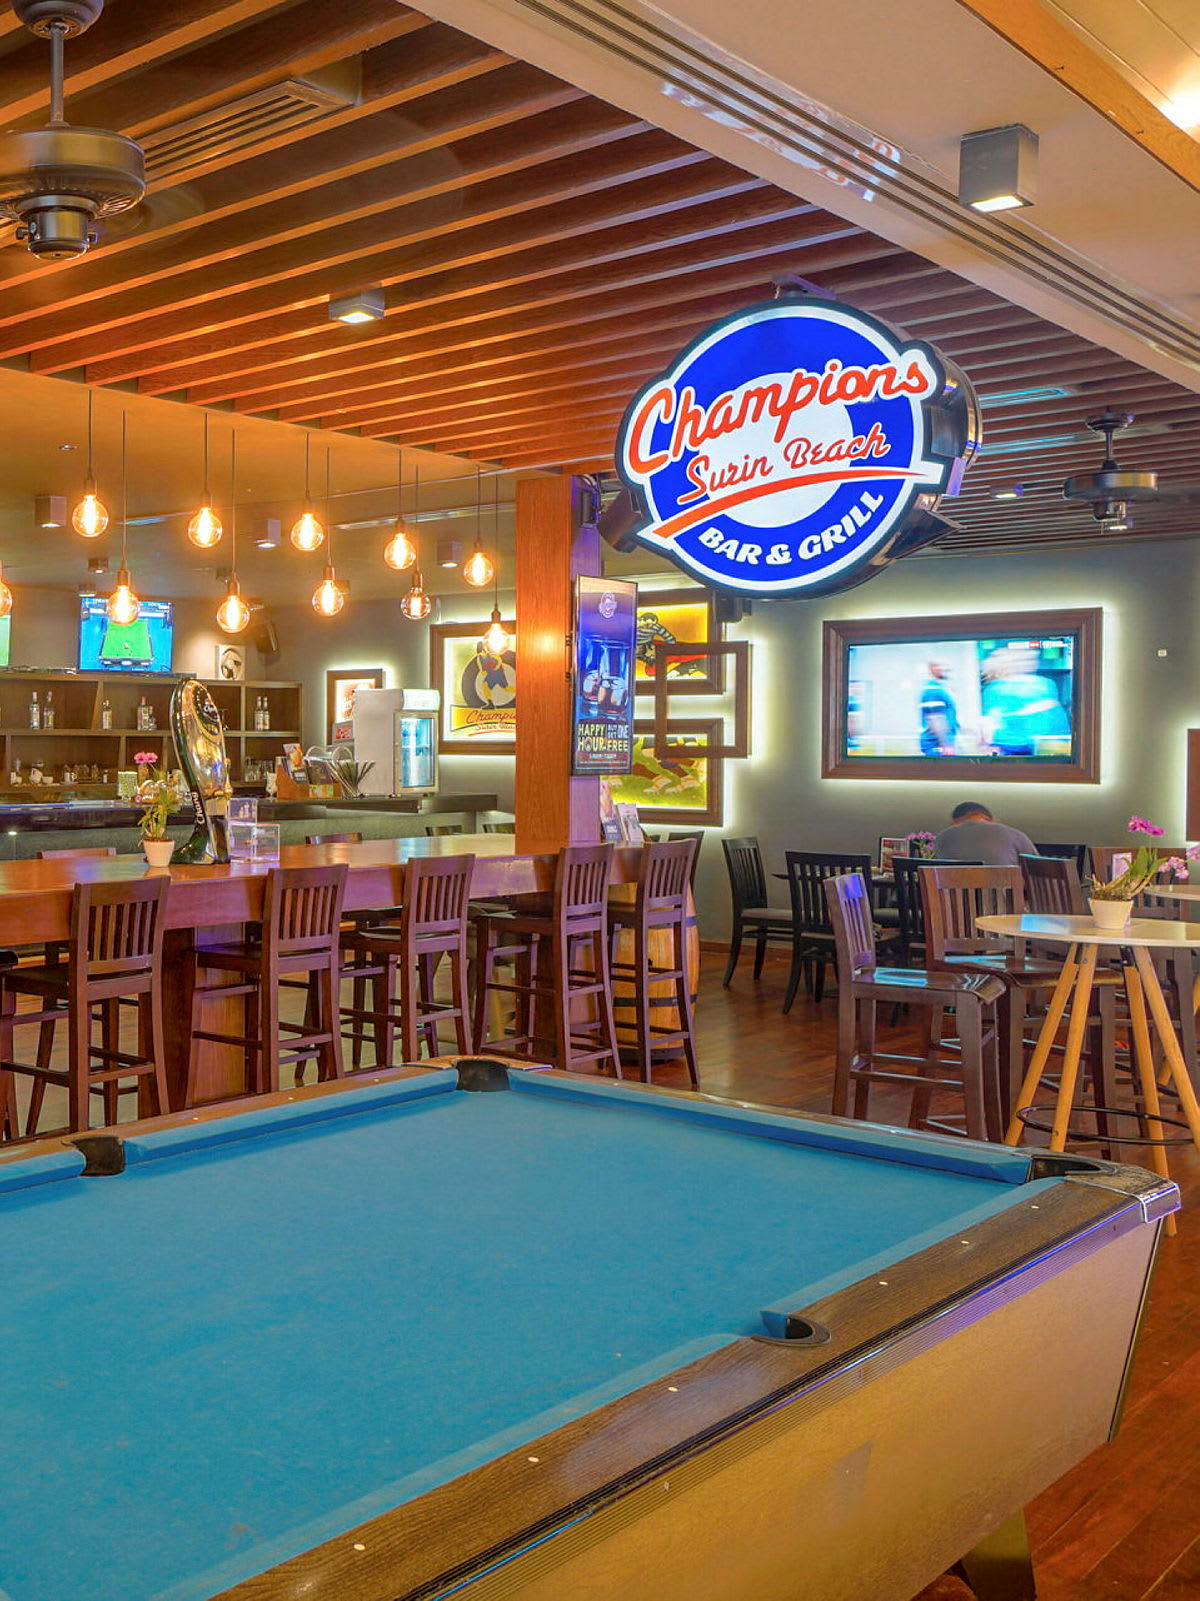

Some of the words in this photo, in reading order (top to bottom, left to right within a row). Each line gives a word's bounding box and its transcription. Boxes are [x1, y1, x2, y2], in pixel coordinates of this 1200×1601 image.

[628, 362, 929, 475] Champions
[677, 454, 773, 506] Surin
[783, 422, 891, 470] Beach
[698, 526, 761, 565] BAR
[766, 544, 792, 565] &
[798, 491, 884, 558] GRILL
[466, 709, 516, 724] Champi
[578, 723, 605, 737] HAPPY
[577, 736, 606, 752] HOUR
[607, 739, 628, 752] FREE
